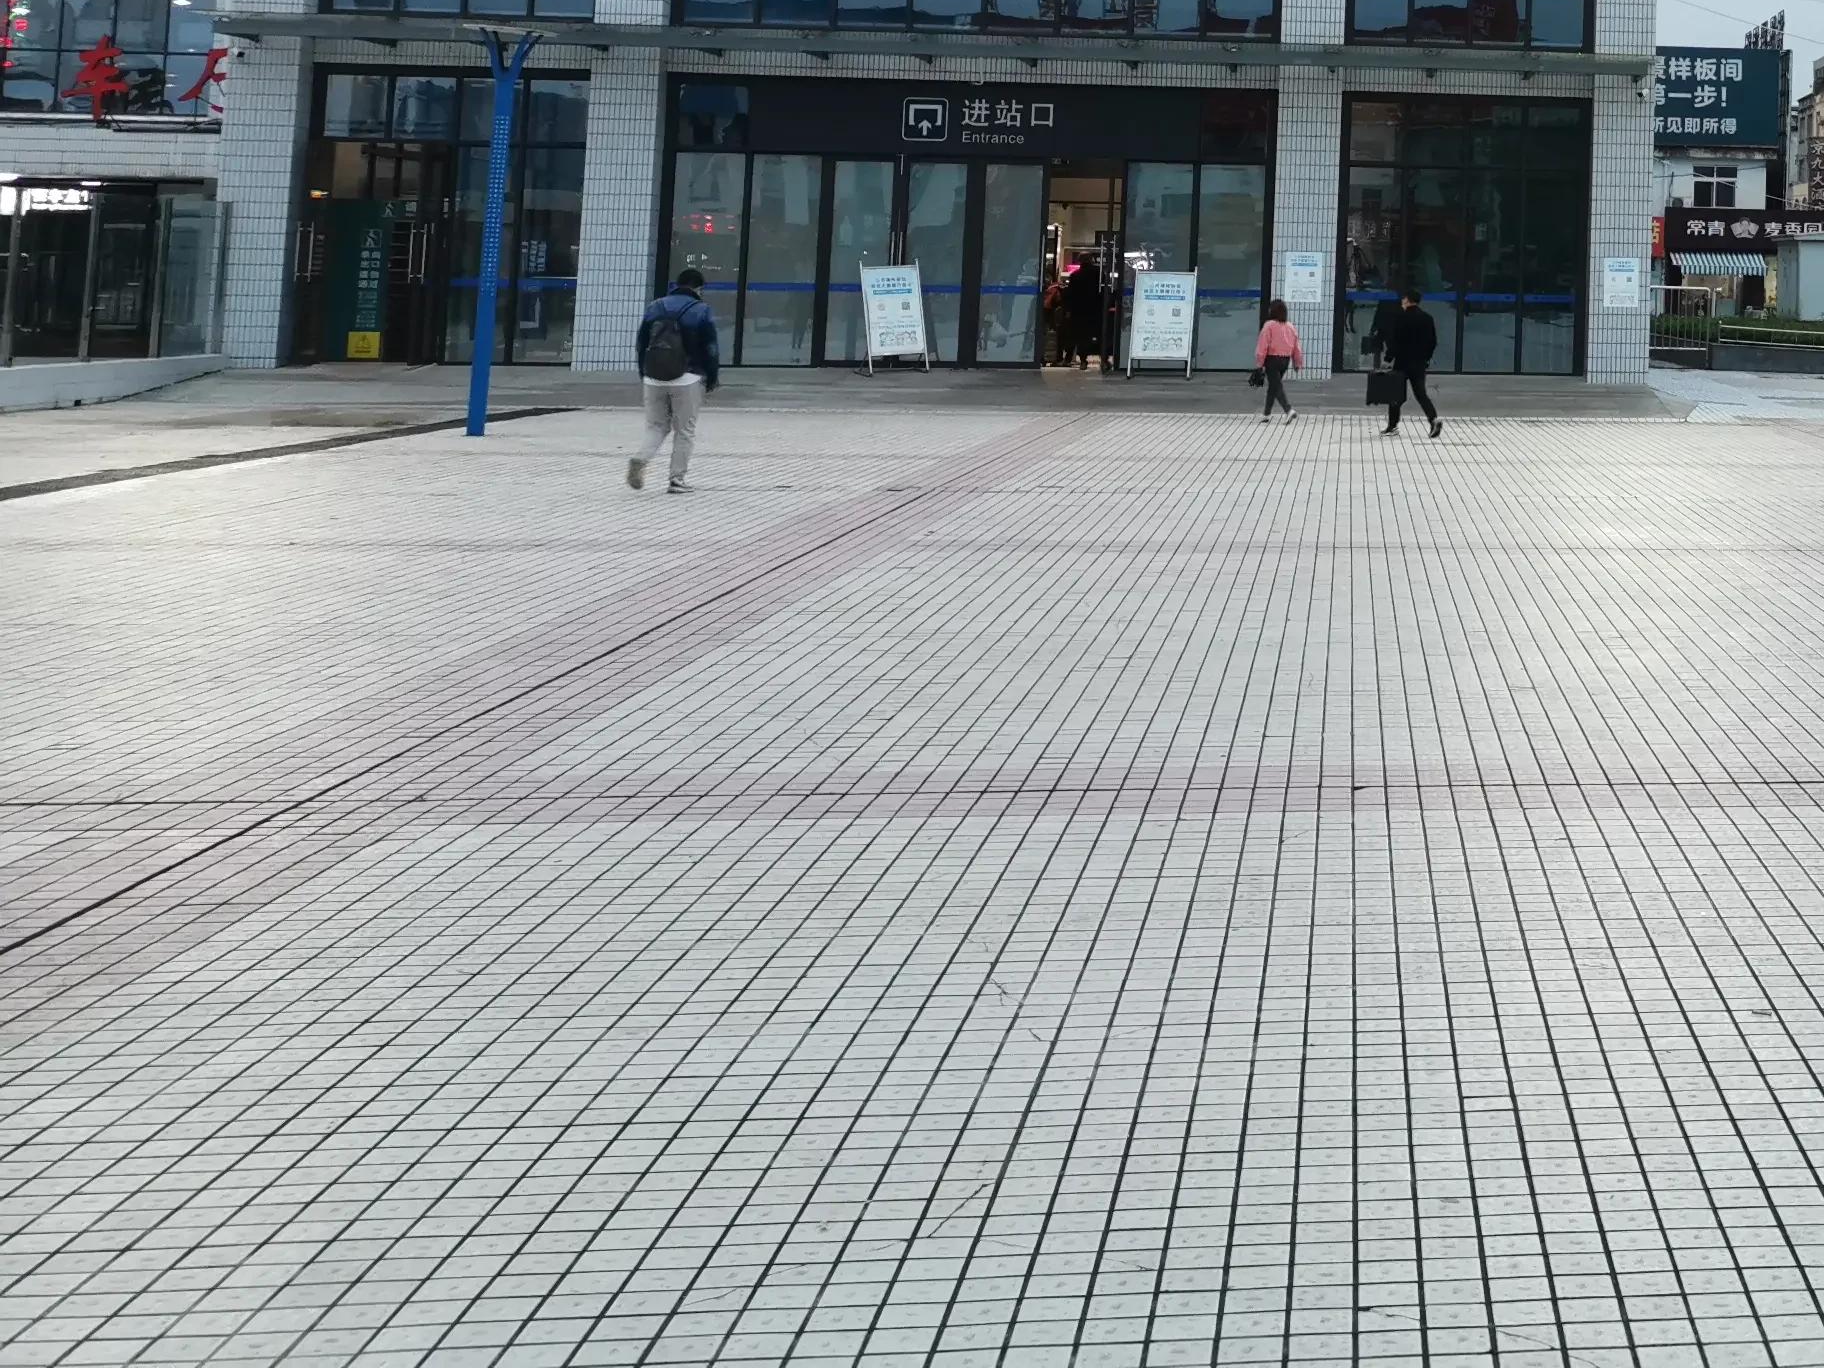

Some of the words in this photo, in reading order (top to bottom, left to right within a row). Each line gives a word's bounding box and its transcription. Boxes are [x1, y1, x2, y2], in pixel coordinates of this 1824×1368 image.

[961, 98, 1054, 127] 进站口
[1653, 116, 1737, 135] 所见即所得
[962, 131, 1024, 144] Entrance
[1687, 220, 1726, 237] 常青
[1764, 221, 1822, 237] 麦香园
